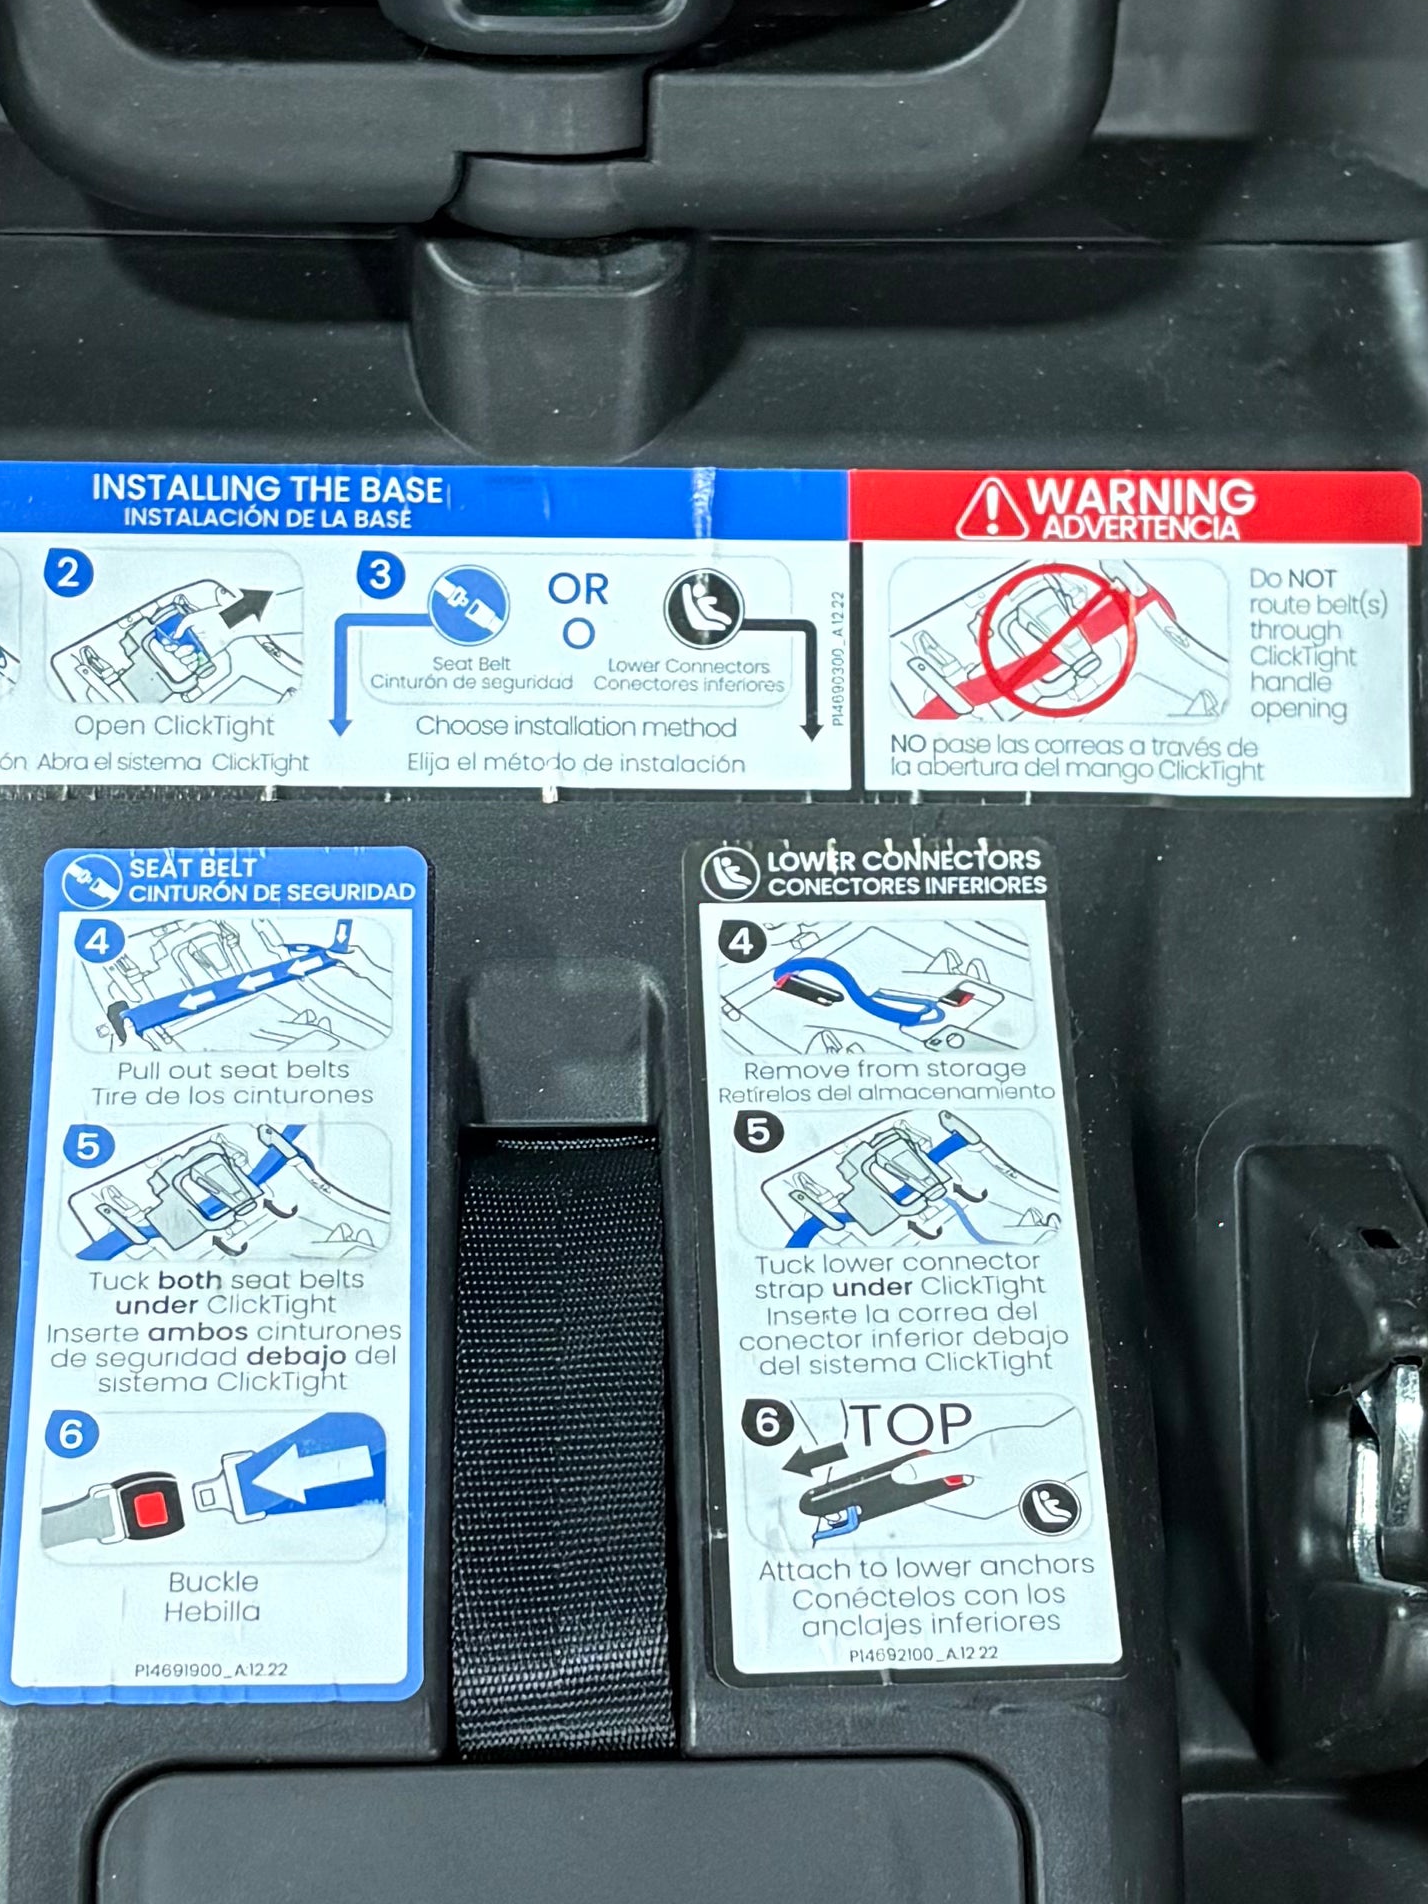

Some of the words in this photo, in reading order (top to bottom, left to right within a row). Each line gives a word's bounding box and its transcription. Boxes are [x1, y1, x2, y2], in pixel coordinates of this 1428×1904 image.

[92, 473, 281, 502] INSTALLING
[288, 475, 351, 503] THE
[360, 476, 443, 504] BASE
[1026, 477, 1256, 516] WARNING
[124, 504, 279, 528] INSTALACIÓN
[285, 508, 315, 528] DE
[320, 508, 348, 529] LA
[353, 505, 412, 529] BASE
[1042, 514, 1241, 542] ADVERTENCIA
[56, 556, 80, 588] 2
[369, 559, 391, 590] 3
[1250, 567, 1282, 588] Do
[1288, 568, 1338, 589] NOT
[547, 571, 609, 605] OR
[1249, 594, 1311, 615] route
[1316, 589, 1388, 619] belt(s)
[562, 616, 596, 650] O
[1249, 618, 1342, 647] through
[432, 655, 473, 672] Seat
[478, 655, 511, 672] Belt
[607, 657, 661, 673] Lower
[664, 657, 771, 675] Connectors
[1249, 644, 1357, 674] ClickTight
[369, 673, 448, 690] Cinturón
[452, 674, 477, 690] de
[481, 674, 574, 695] seguridad
[592, 675, 699, 692] Conectores
[703, 676, 785, 693] inferiores
[1250, 670, 1332, 693] handle
[1250, 698, 1348, 726] opening
[74, 714, 145, 741] Open
[153, 714, 275, 741] ClickTight
[415, 714, 509, 736] Choose
[514, 714, 636, 737] installation
[642, 716, 737, 738] method
[890, 733, 927, 758] NO
[932, 737, 992, 758] pase
[996, 733, 1030, 754] las
[1034, 738, 1124, 759] correas
[1128, 739, 1145, 756] a
[1151, 735, 1222, 758] través
[1226, 736, 1259, 758] de
[890, 756, 911, 777] la
[916, 757, 1019, 777] abertura
[1023, 758, 1060, 777] del
[1065, 760, 1154, 784] mango
[1158, 758, 1265, 786] ClickTight
[129, 856, 194, 879] SEAT
[199, 856, 258, 878] BELT
[767, 850, 856, 873] LOWER
[861, 848, 1042, 872] CONNECTORS
[127, 879, 248, 903] CINTURÓN
[252, 883, 282, 902] DE
[286, 882, 416, 902] SEGURIDAD
[767, 876, 921, 897] CONECTORES
[924, 874, 1048, 895] INFERIORES
[84, 926, 110, 955] 4
[727, 927, 754, 956] 4
[117, 1061, 160, 1081] Pull
[168, 1061, 212, 1080] out
[219, 1061, 278, 1080] seat
[286, 1059, 350, 1079] belts
[744, 1061, 850, 1081] Remove
[857, 1060, 919, 1078] from
[926, 1060, 1027, 1084] storage
[91, 1087, 137, 1106] Tire
[145, 1085, 180, 1105] de
[188, 1085, 225, 1105] los
[233, 1085, 374, 1105] cinturones
[746, 1117, 770, 1146] 5
[76, 1131, 100, 1161] 5
[89, 1271, 149, 1291] Tuck
[158, 1269, 223, 1290] both
[230, 1270, 290, 1290] seat
[299, 1268, 365, 1289] belts
[115, 1294, 199, 1315] under
[207, 1293, 336, 1320] ClickTight
[58, 1420, 84, 1450] 6
[755, 1406, 780, 1438] 6
[849, 1402, 972, 1447] TOP
[168, 1569, 259, 1593] Buckle
[758, 1557, 851, 1582] Attach
[859, 1559, 888, 1579] to
[896, 1556, 972, 1579] lower
[979, 1554, 1095, 1576] anchors
[164, 1599, 261, 1623] Hebilla
